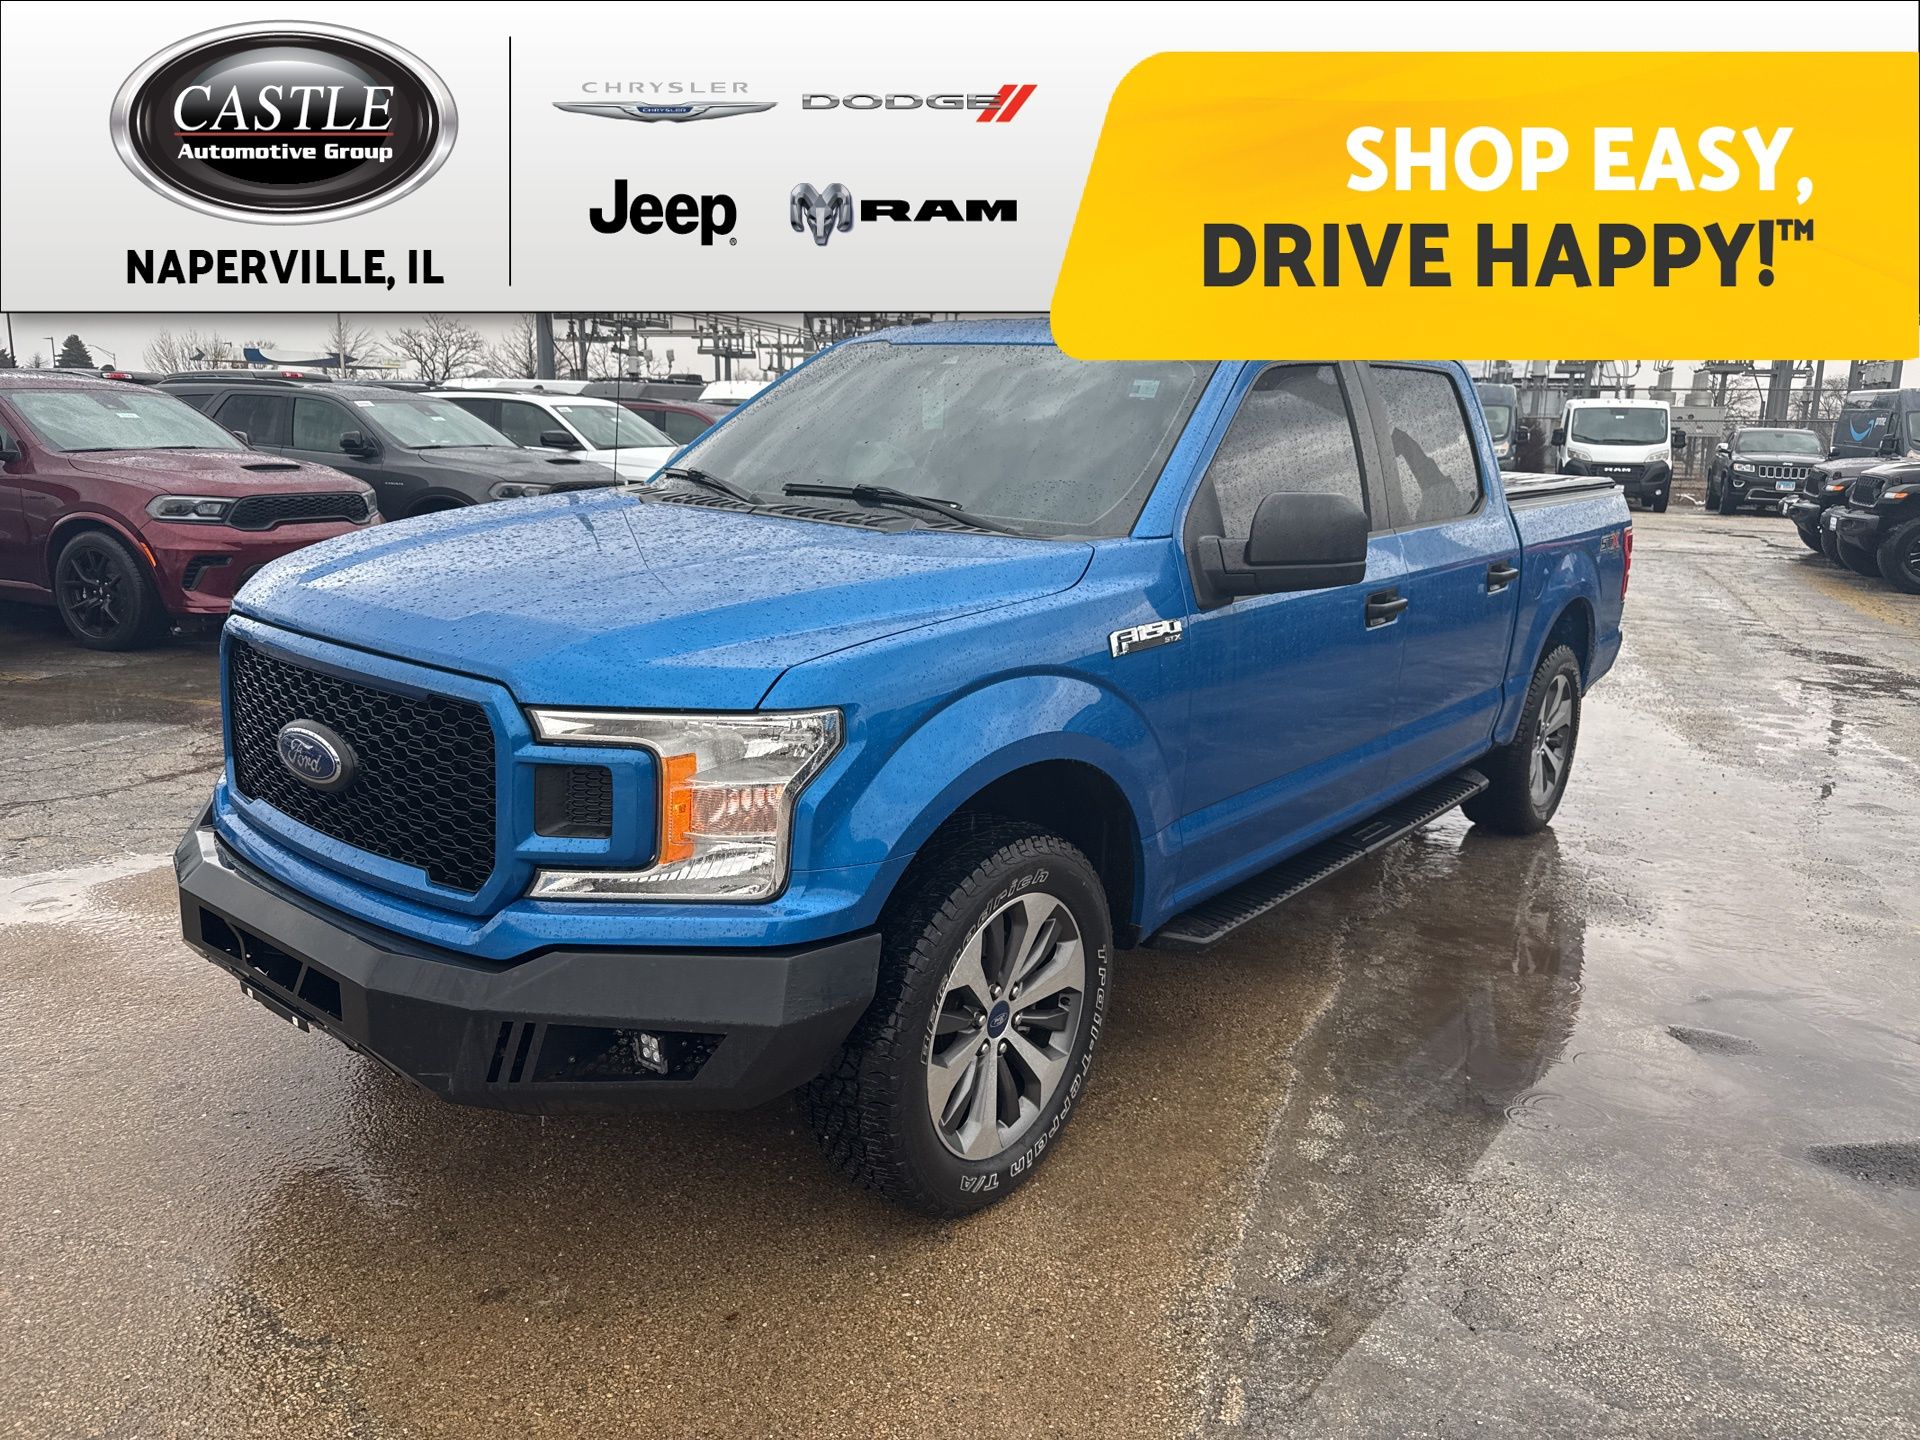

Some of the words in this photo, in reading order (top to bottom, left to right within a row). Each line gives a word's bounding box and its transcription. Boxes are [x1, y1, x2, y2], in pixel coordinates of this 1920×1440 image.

[1164, 633, 1182, 643] STX
[287, 738, 322, 773] Ford
[960, 1172, 999, 1194] T/A
